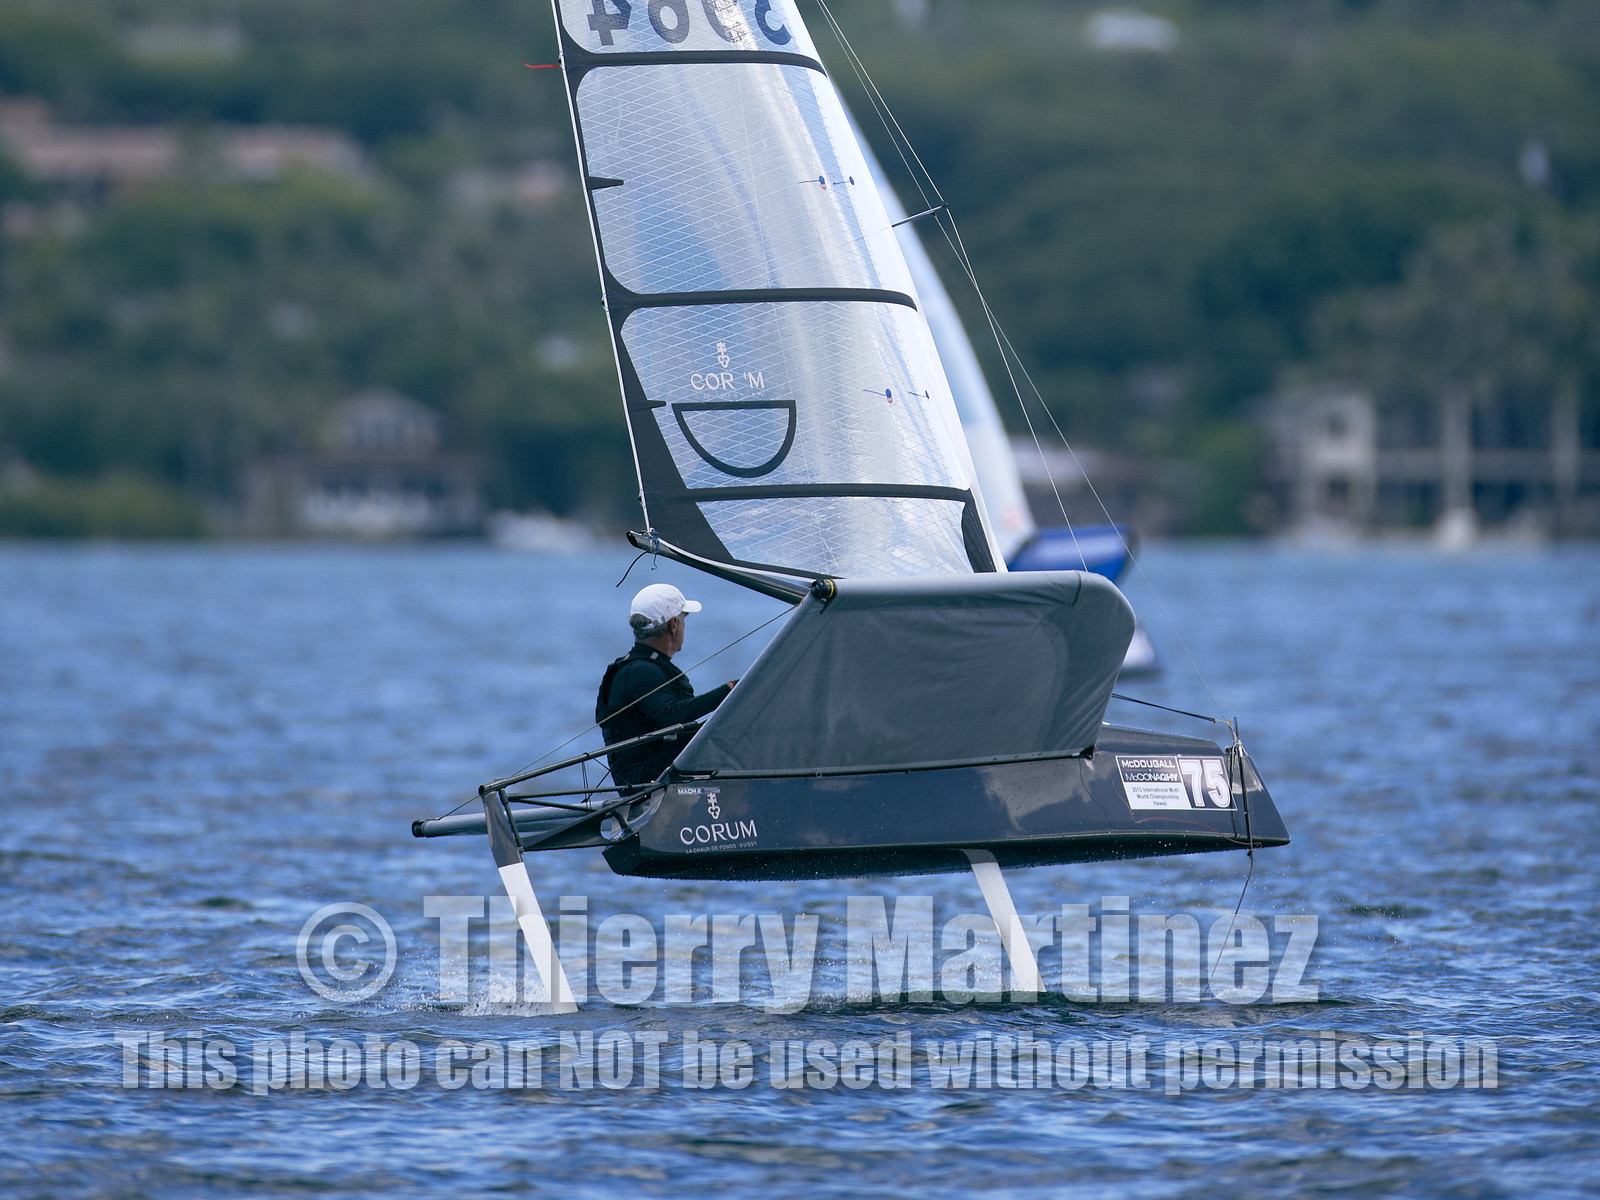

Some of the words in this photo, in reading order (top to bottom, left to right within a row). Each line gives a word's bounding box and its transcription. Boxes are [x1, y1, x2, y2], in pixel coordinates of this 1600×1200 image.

[691, 371, 765, 391] CORM
[1121, 759, 1176, 768] McDOUGALL
[1125, 772, 1178, 782] McCONAGHY
[1179, 758, 1232, 808] 75
[680, 819, 758, 845] CORUM
